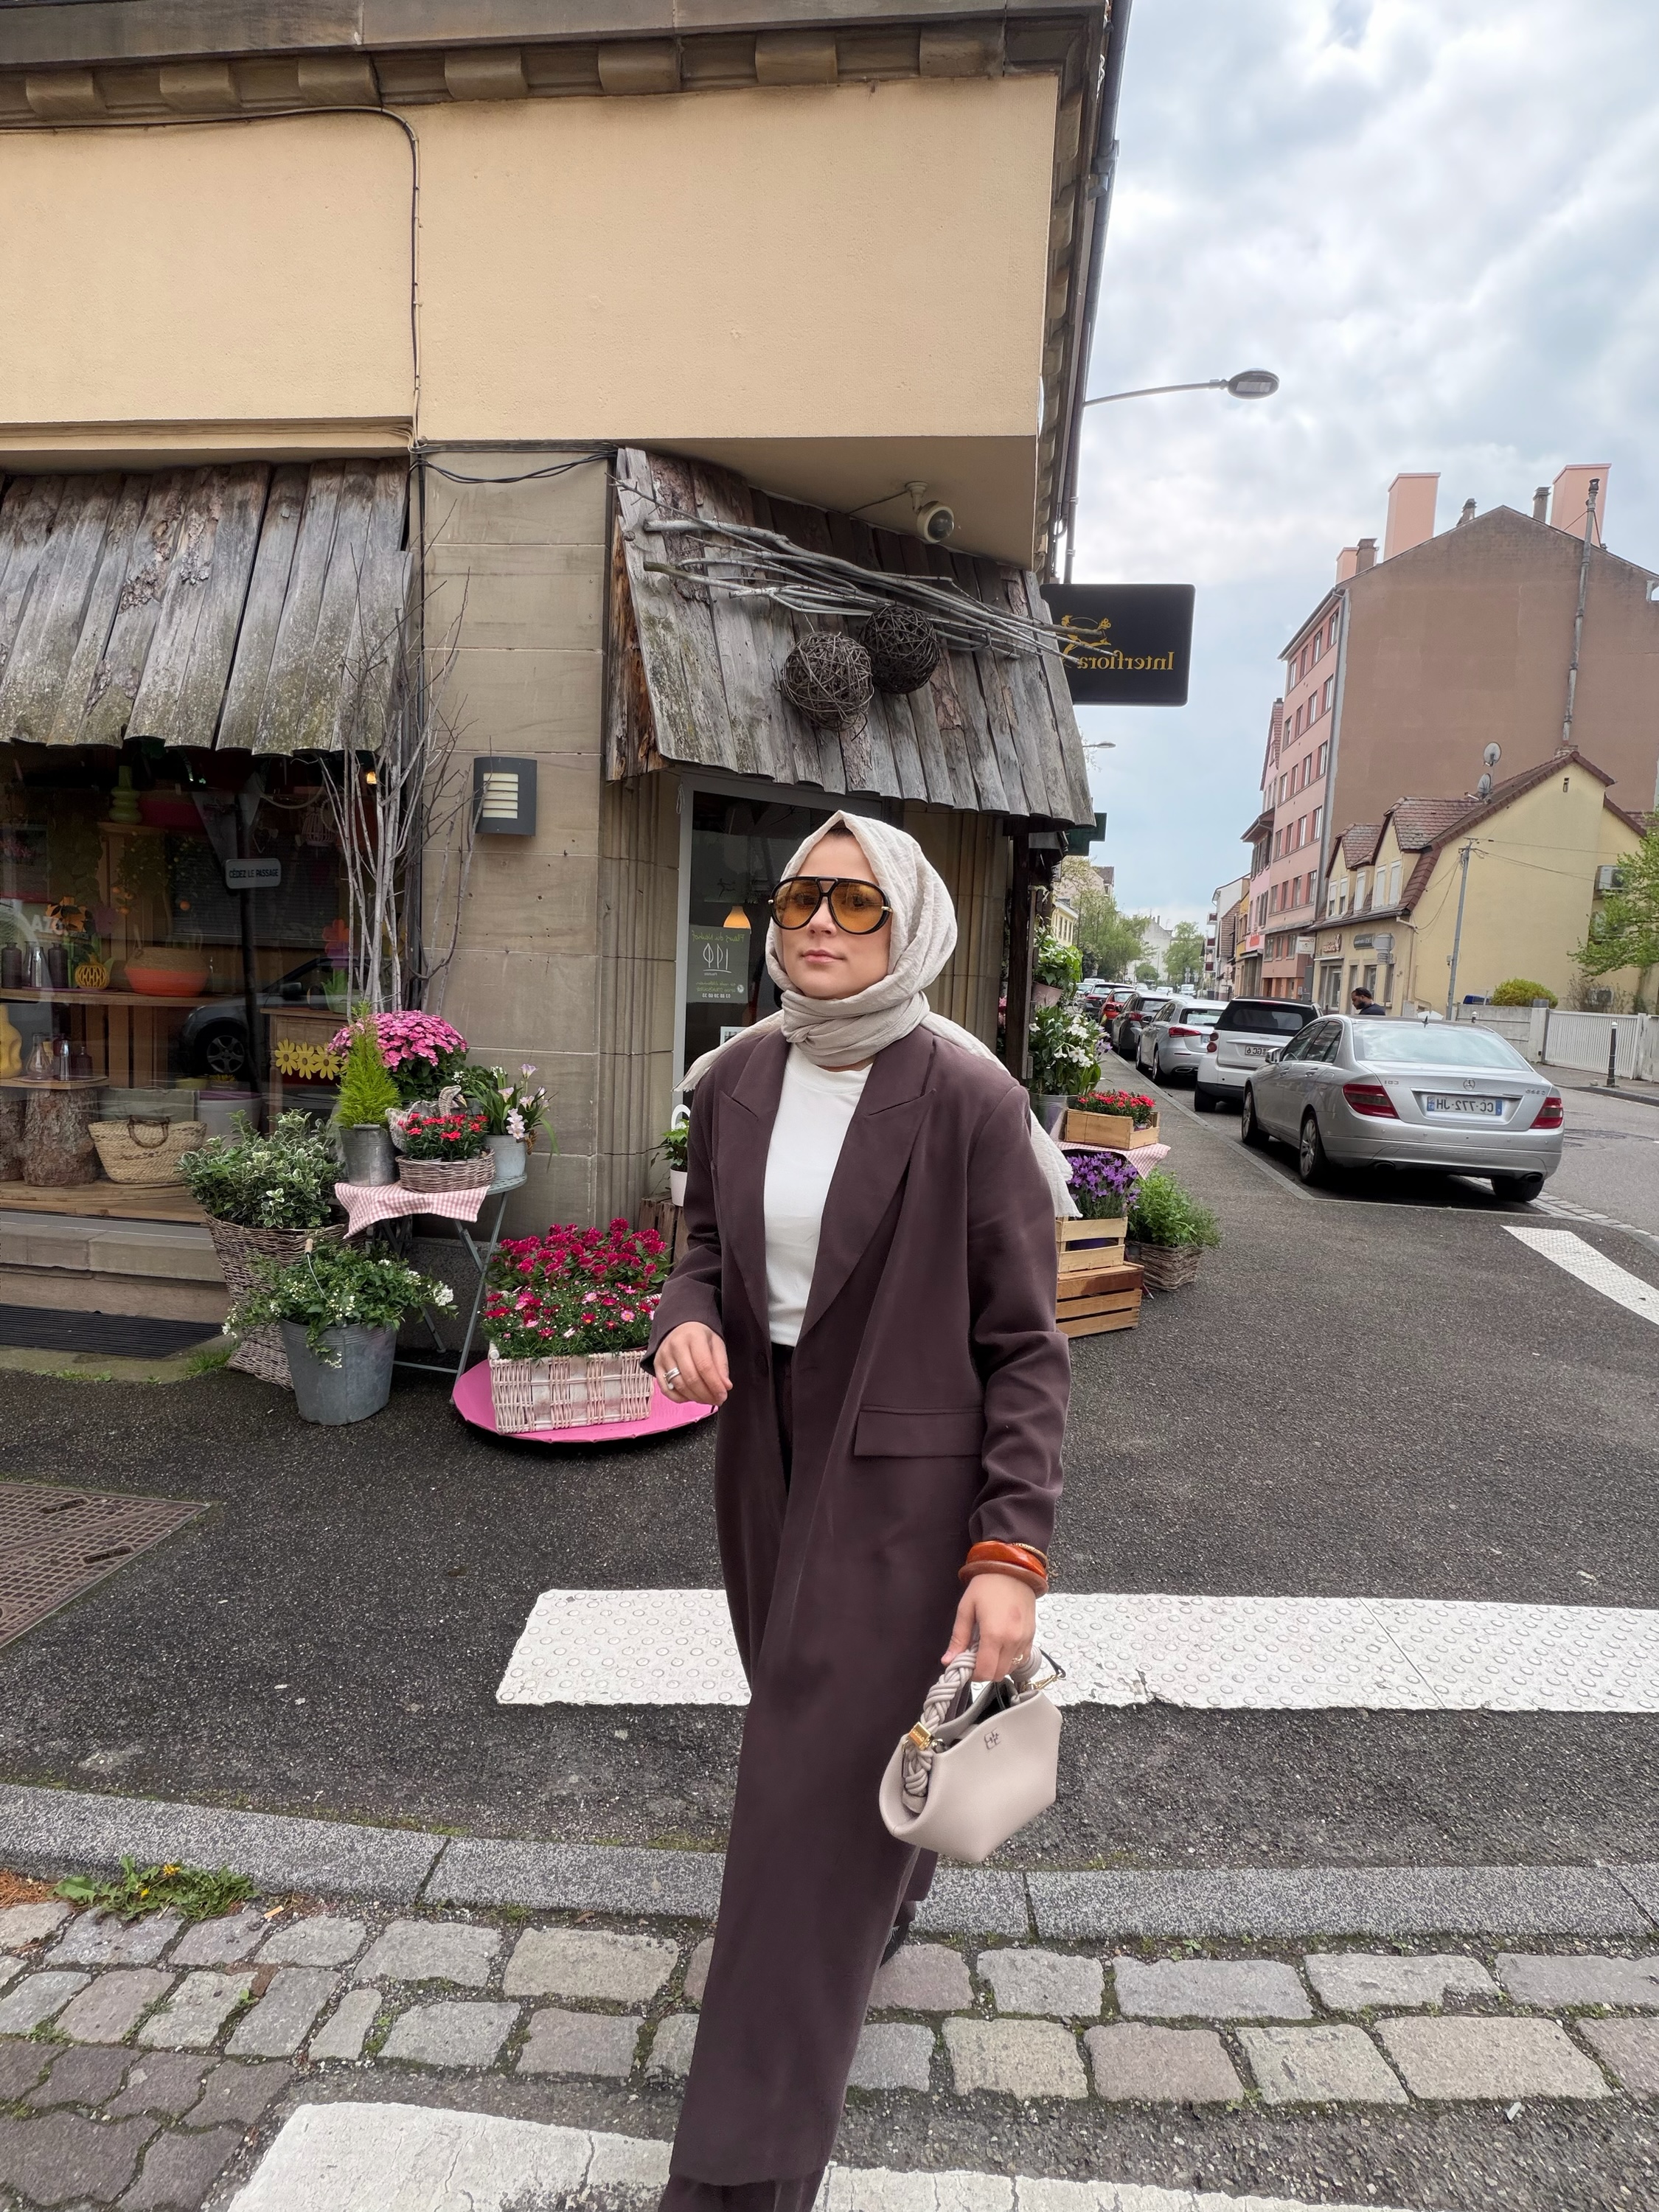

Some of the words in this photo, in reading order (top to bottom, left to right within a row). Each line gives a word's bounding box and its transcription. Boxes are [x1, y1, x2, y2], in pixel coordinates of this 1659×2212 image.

[229, 868, 246, 878] CÉDEZ
[247, 869, 254, 877] LE
[256, 869, 279, 877] PASSAGE
